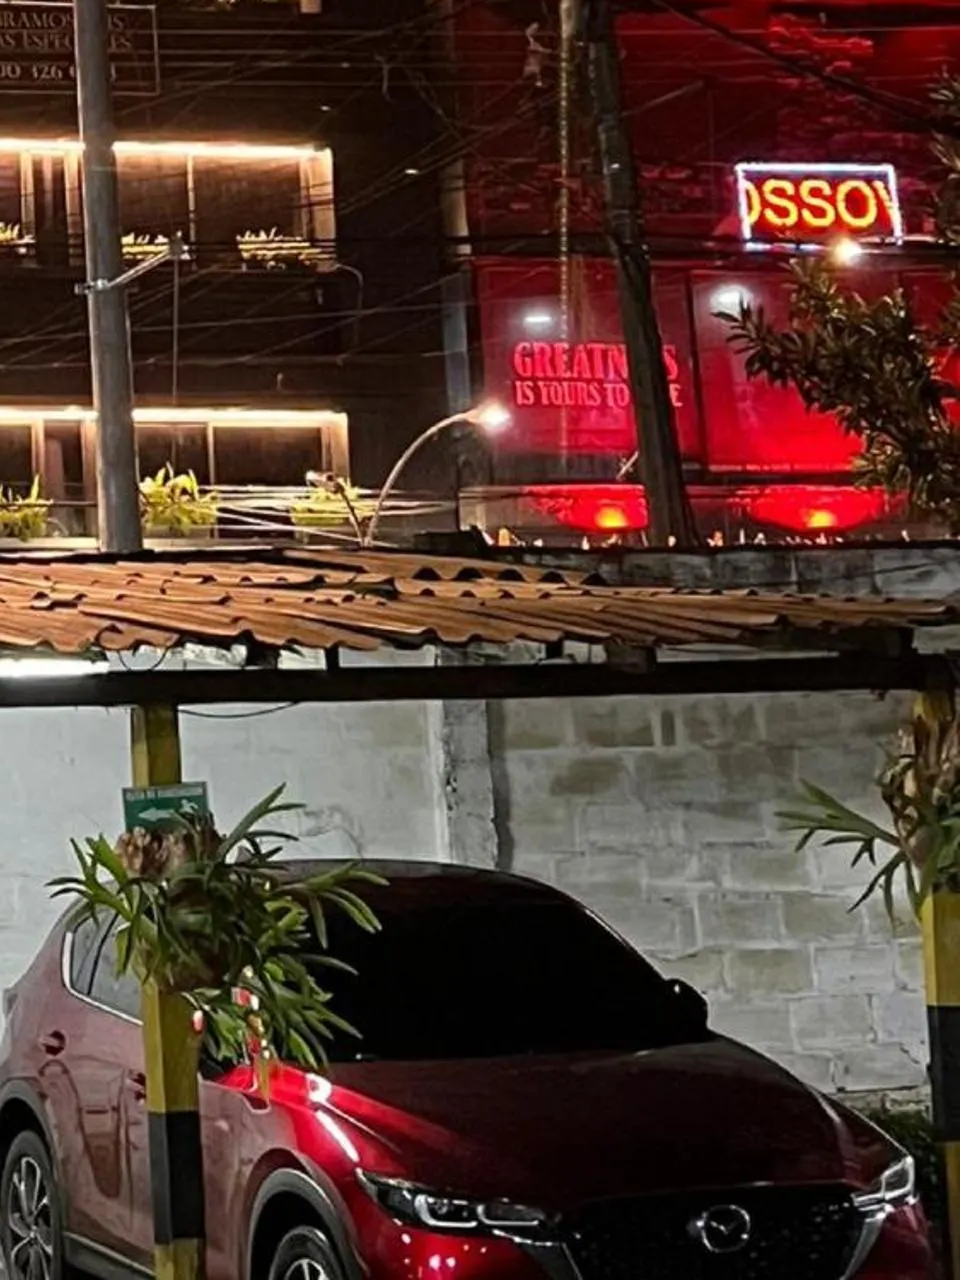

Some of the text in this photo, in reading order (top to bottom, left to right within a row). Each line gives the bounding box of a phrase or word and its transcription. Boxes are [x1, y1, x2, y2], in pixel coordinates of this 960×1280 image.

[514, 341, 678, 380] GREATNS
[516, 380, 630, 406] IS YOURS TO
